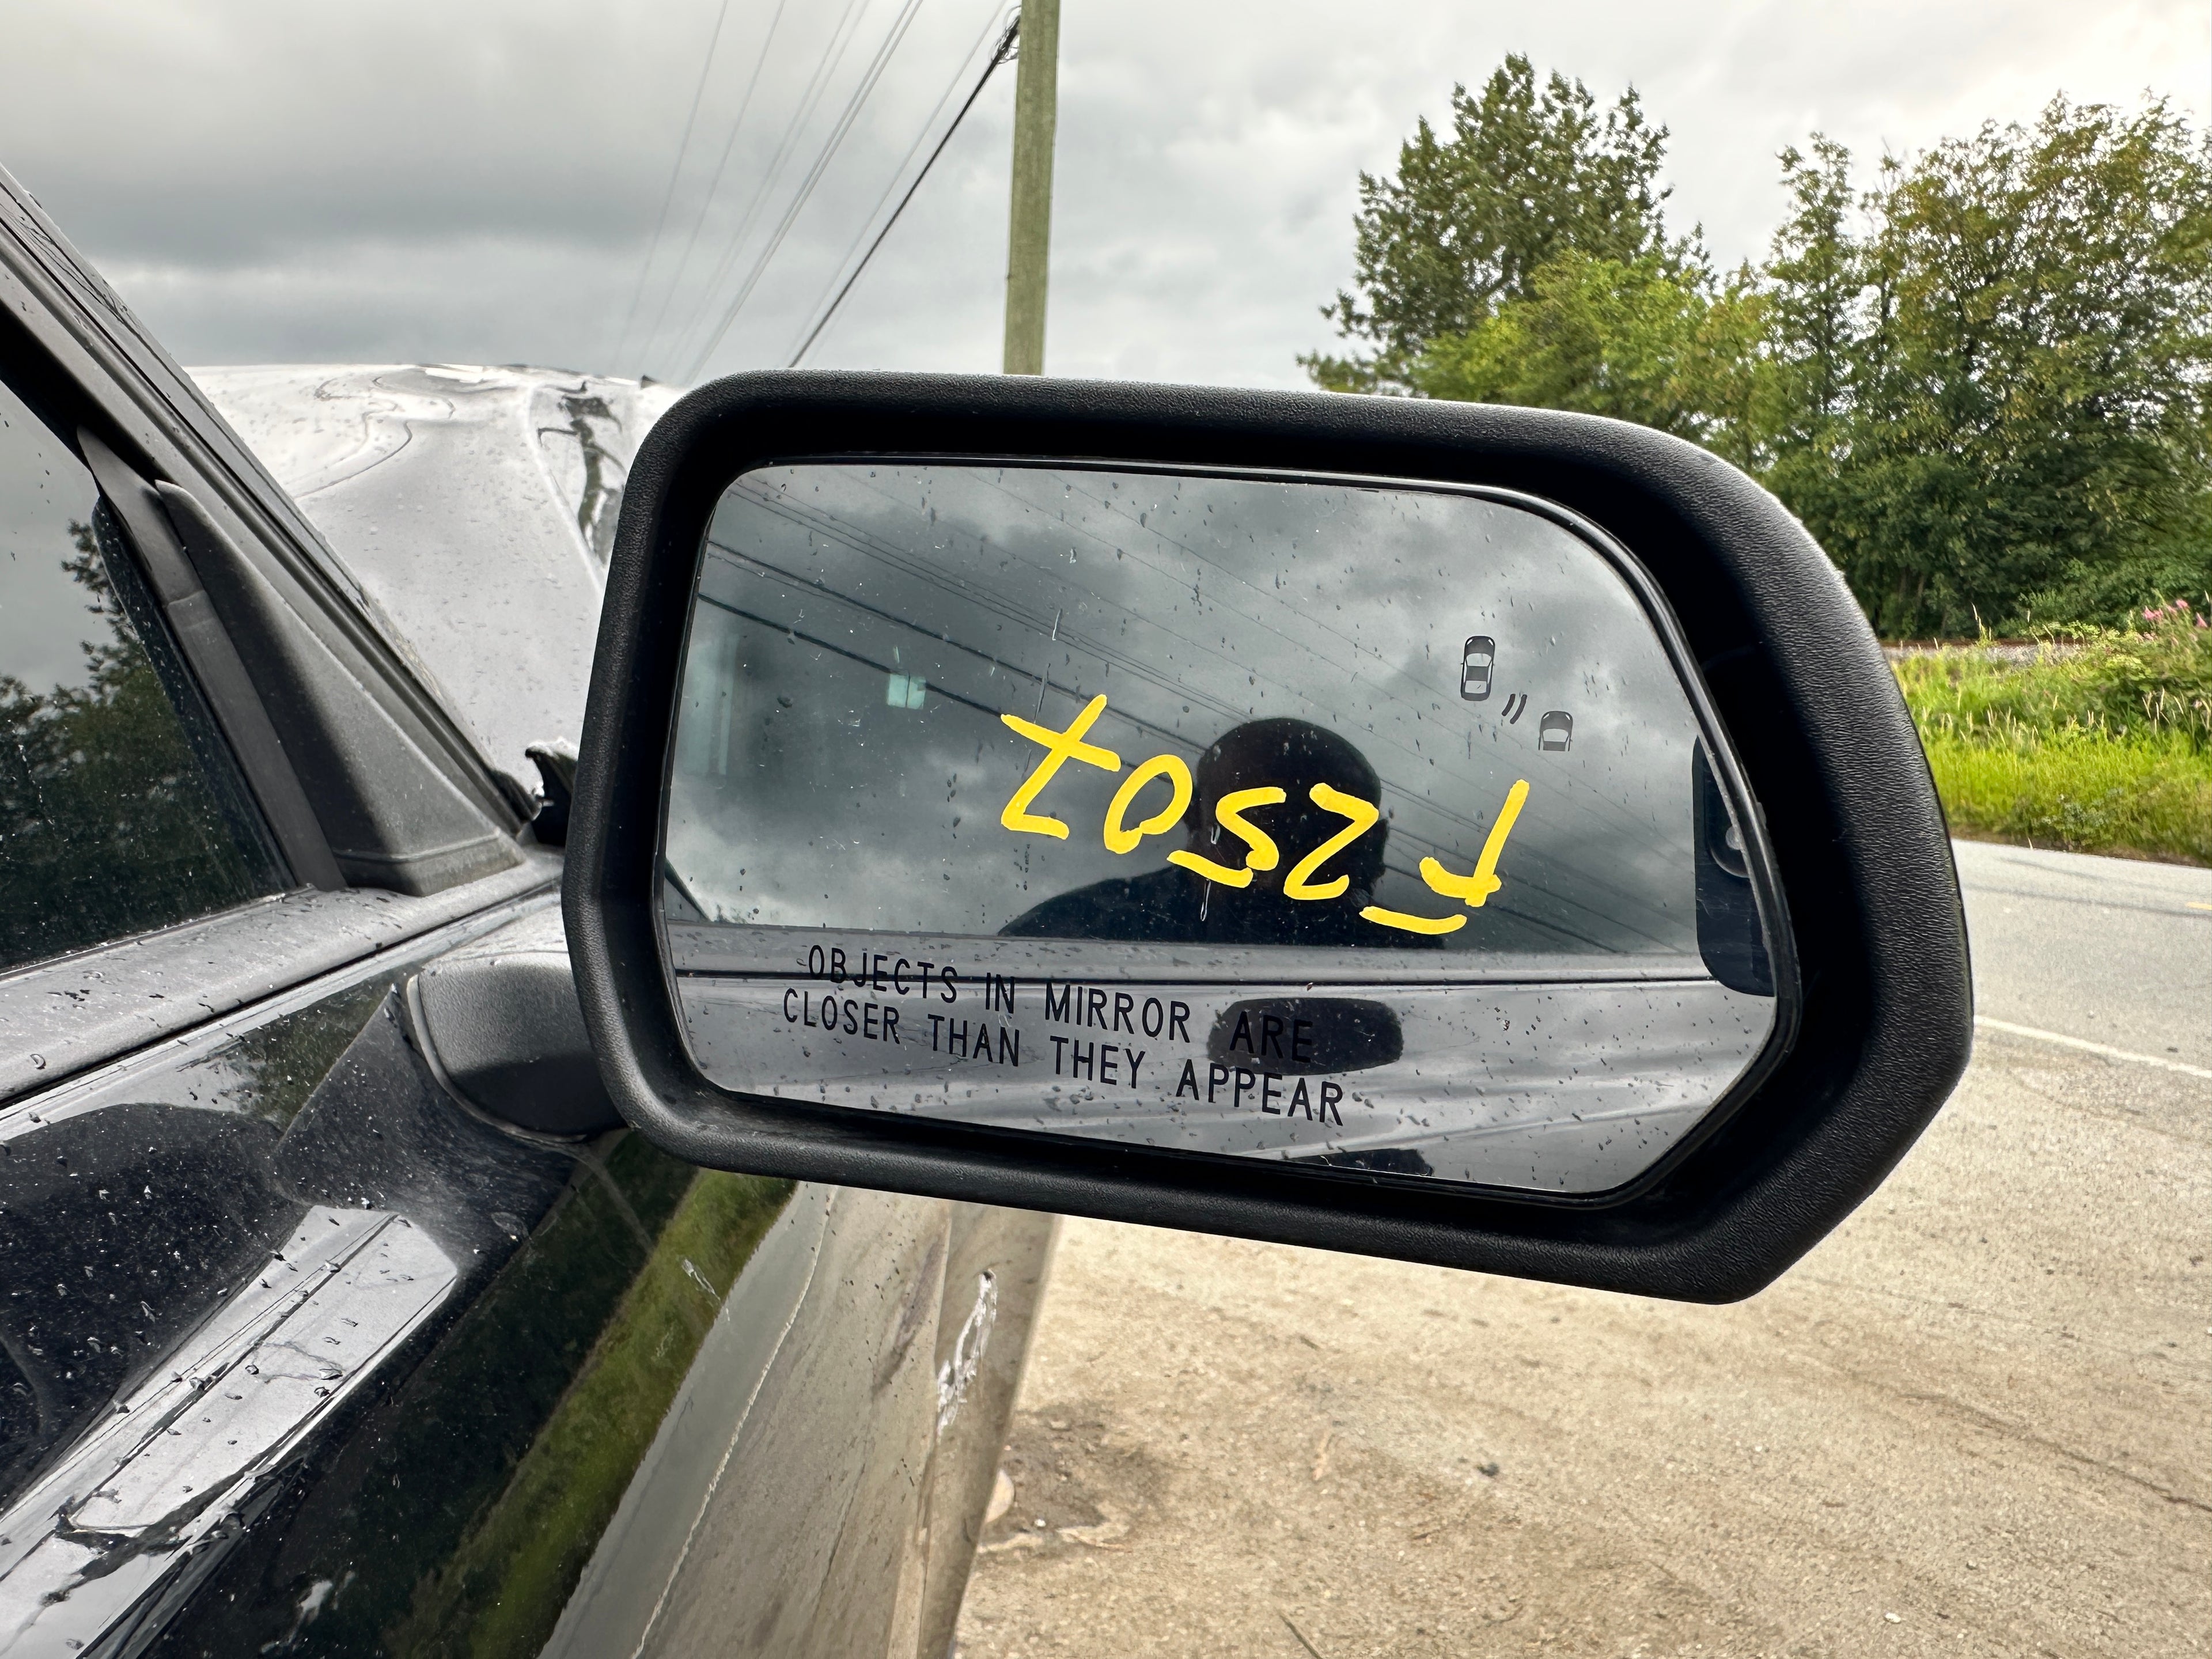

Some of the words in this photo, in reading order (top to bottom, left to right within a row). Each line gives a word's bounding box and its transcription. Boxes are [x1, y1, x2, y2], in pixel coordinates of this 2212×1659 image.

[783, 988, 900, 1044] CLOSER
[927, 1014, 1020, 1067] THAN
[1050, 1035, 1146, 1089] THEY
[1176, 1059, 1344, 1126] APPEAR
[809, 945, 958, 1003] OBJECTS
[985, 972, 1016, 1014] IN
[1045, 982, 1191, 1043] MIRROR
[1229, 1012, 1314, 1063] ARE
